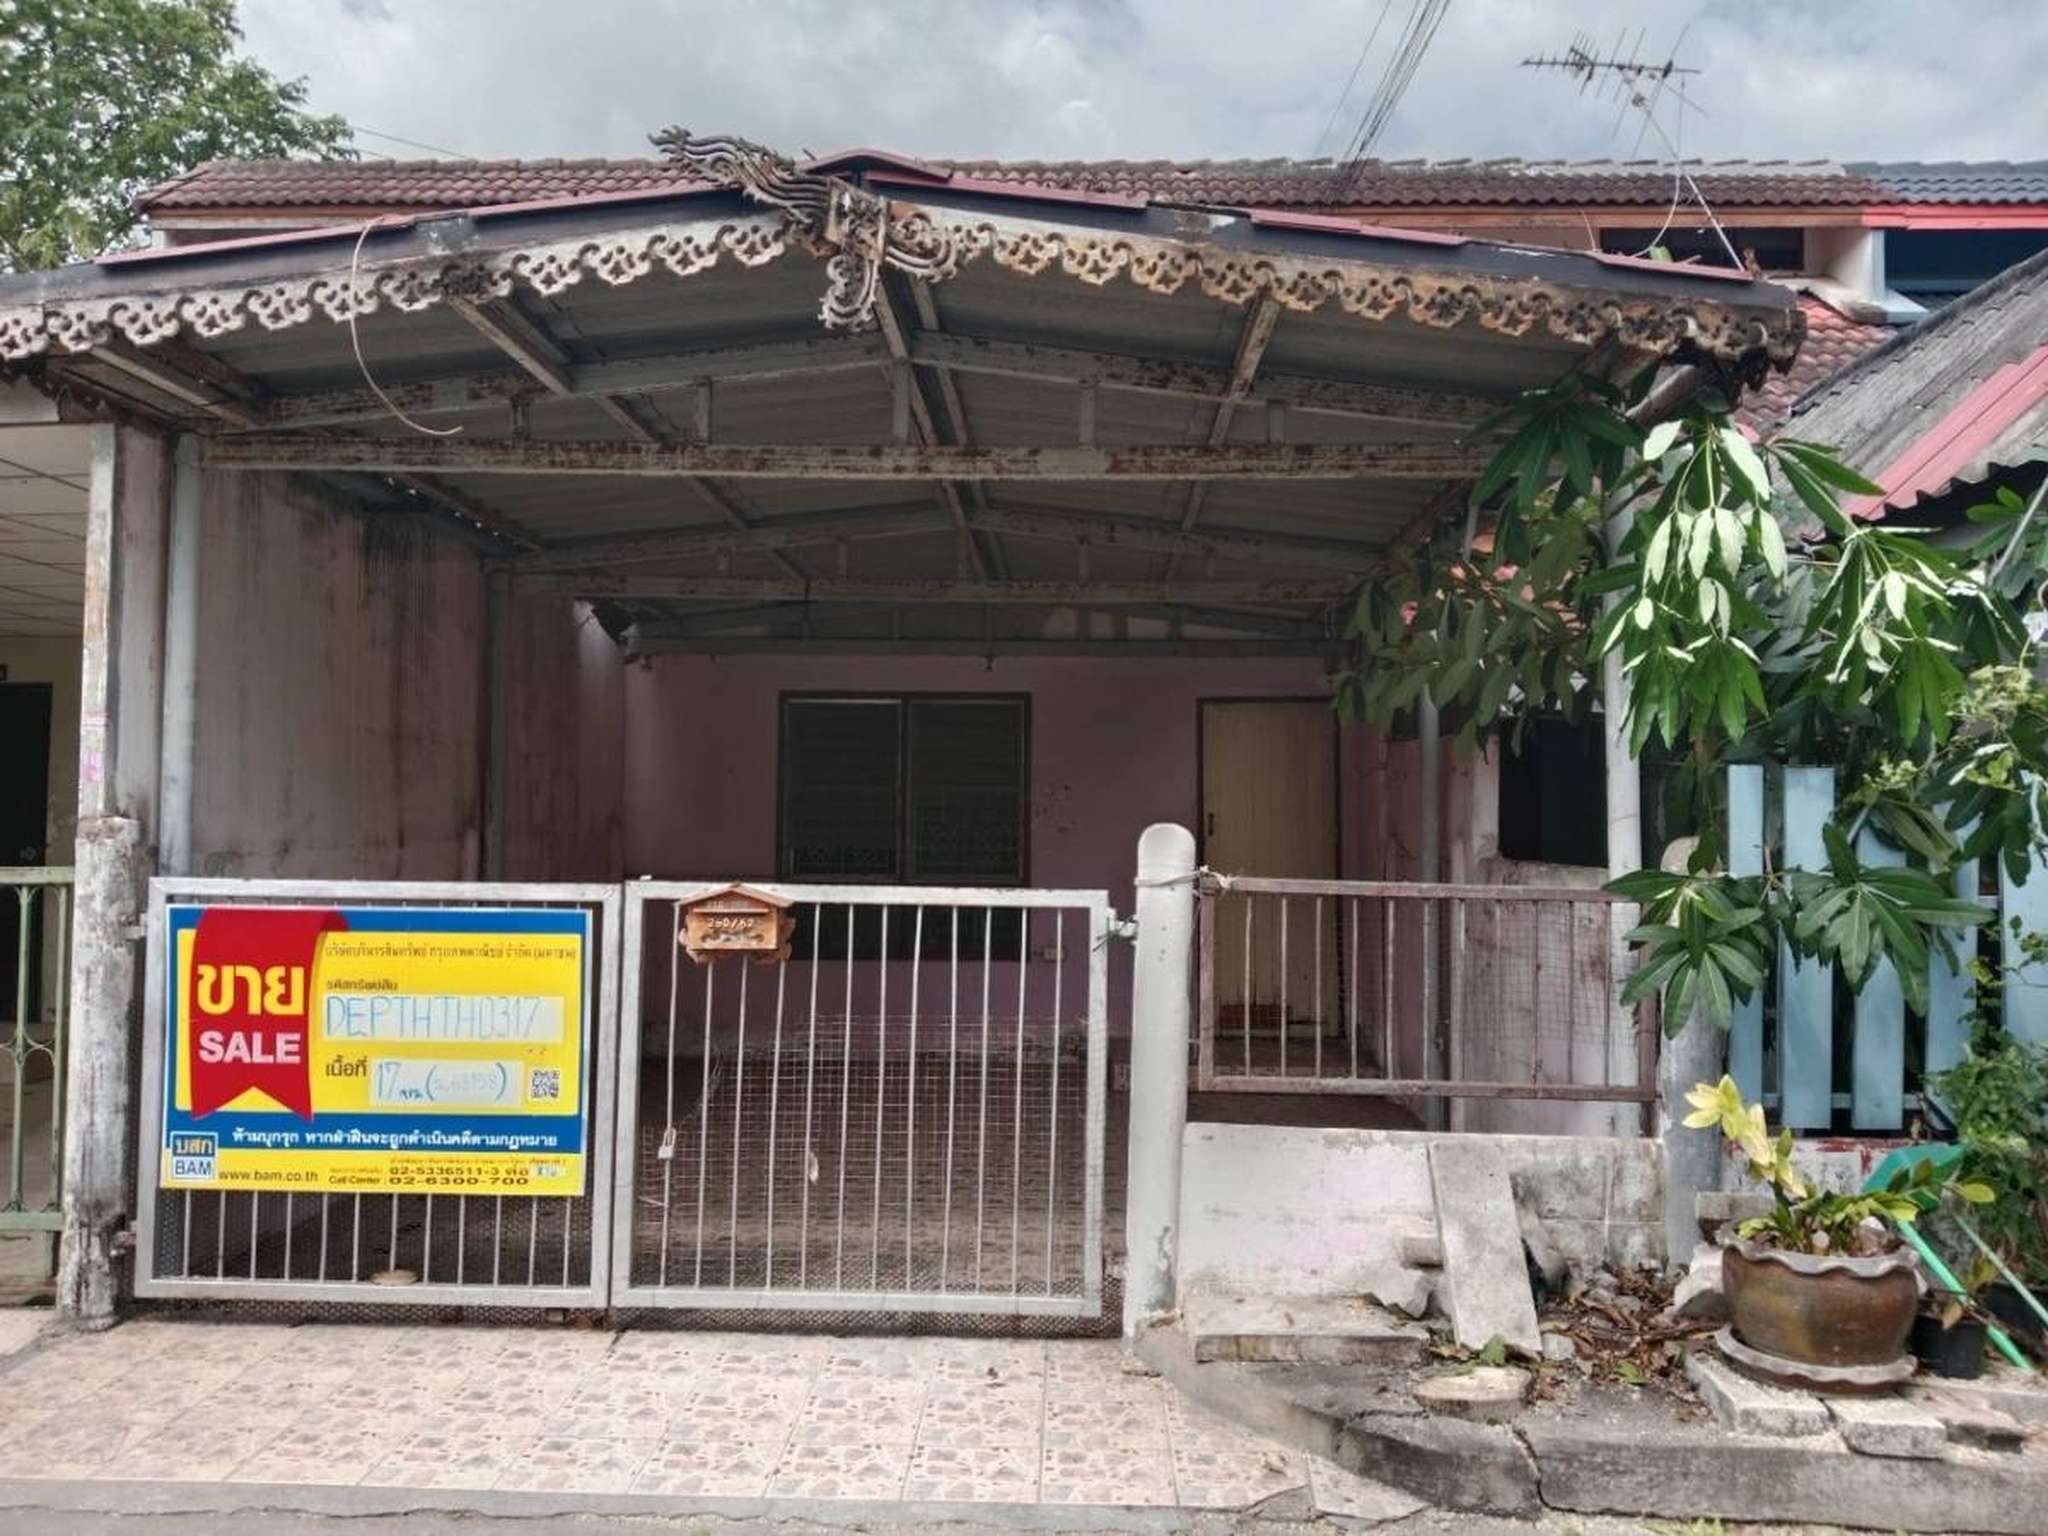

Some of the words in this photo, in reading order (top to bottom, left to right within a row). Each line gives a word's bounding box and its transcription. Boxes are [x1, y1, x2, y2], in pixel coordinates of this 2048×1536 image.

[197, 964, 305, 1016] ขาย
[198, 1029, 302, 1065] SALE
[326, 1054, 367, 1078] เนื้อที่
[175, 1137, 213, 1156] บสก
[231, 1126, 300, 1148] ห้ามบุกรุก
[174, 1160, 213, 1176] BAM
[219, 1169, 319, 1183] www.bam.co.th
[389, 1166, 500, 1176] 02-5336511-3
[328, 1175, 347, 1186] Call
[348, 1175, 381, 1186] Center
[388, 1176, 530, 1186] 02-6300-700
